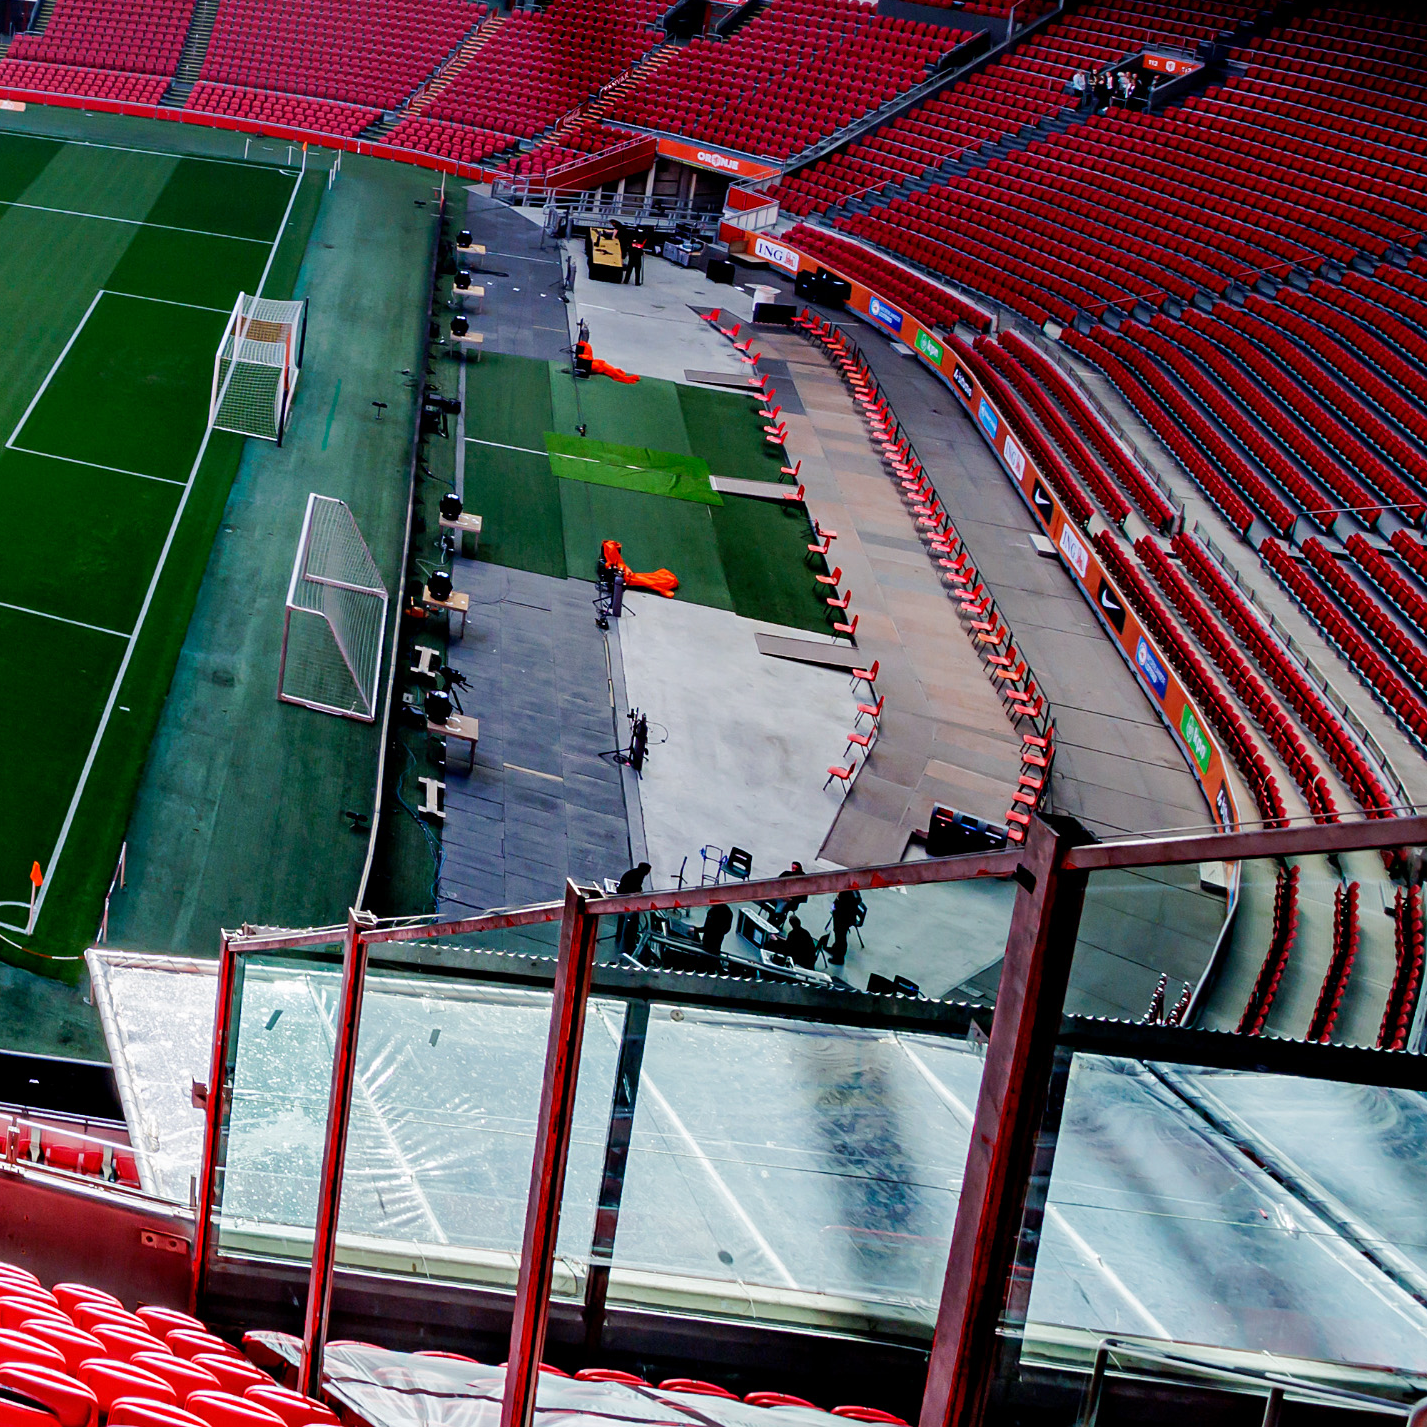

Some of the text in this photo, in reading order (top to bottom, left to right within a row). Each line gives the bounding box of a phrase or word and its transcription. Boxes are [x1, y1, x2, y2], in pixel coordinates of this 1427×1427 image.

[758, 242, 783, 262] ING
[1062, 529, 1077, 554] ING
[1193, 730, 1207, 761] kpn
